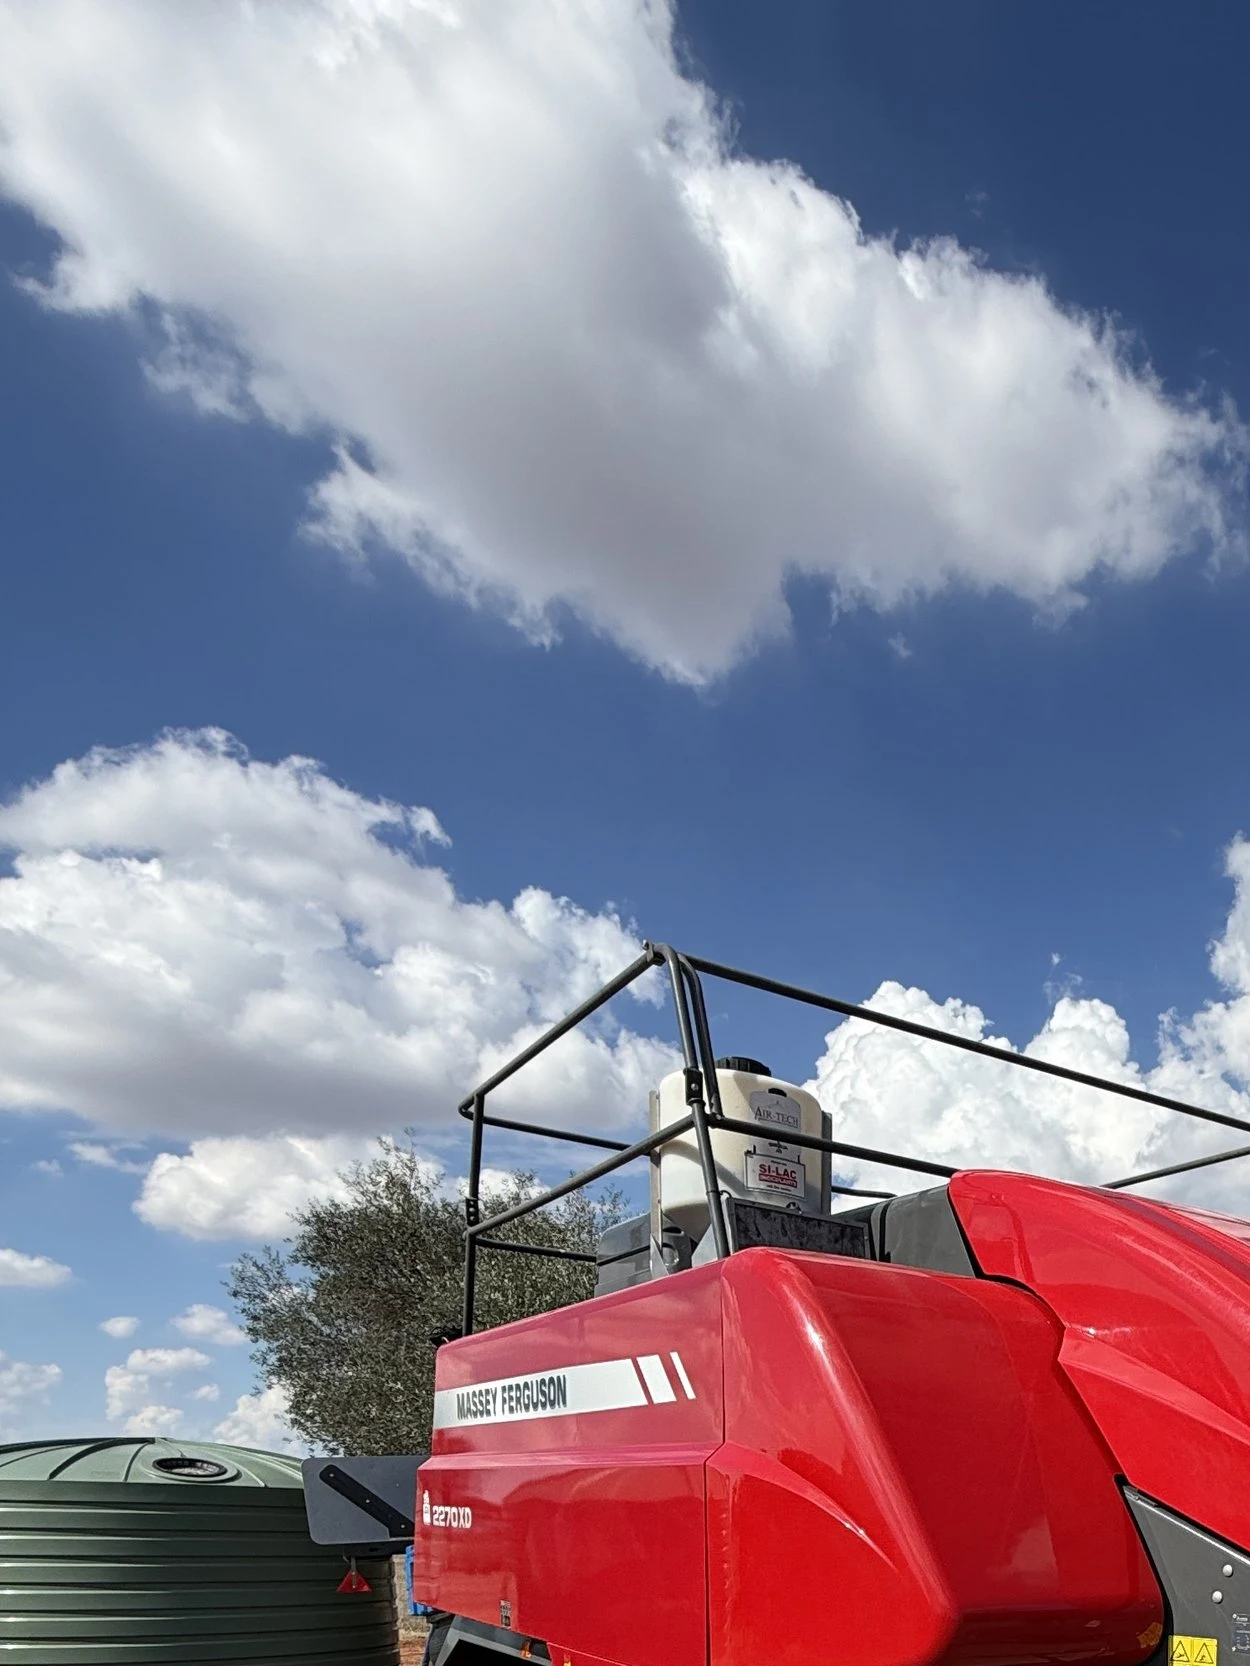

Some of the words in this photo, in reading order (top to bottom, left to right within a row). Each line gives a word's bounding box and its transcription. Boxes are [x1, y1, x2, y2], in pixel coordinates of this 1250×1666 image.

[754, 1106, 799, 1127] AIR-TECH
[759, 1163, 797, 1180] SI-LAC
[456, 1386, 498, 1420] MASSEY
[501, 1374, 567, 1416] FERGUSON
[432, 1505, 472, 1529] 2270XD
